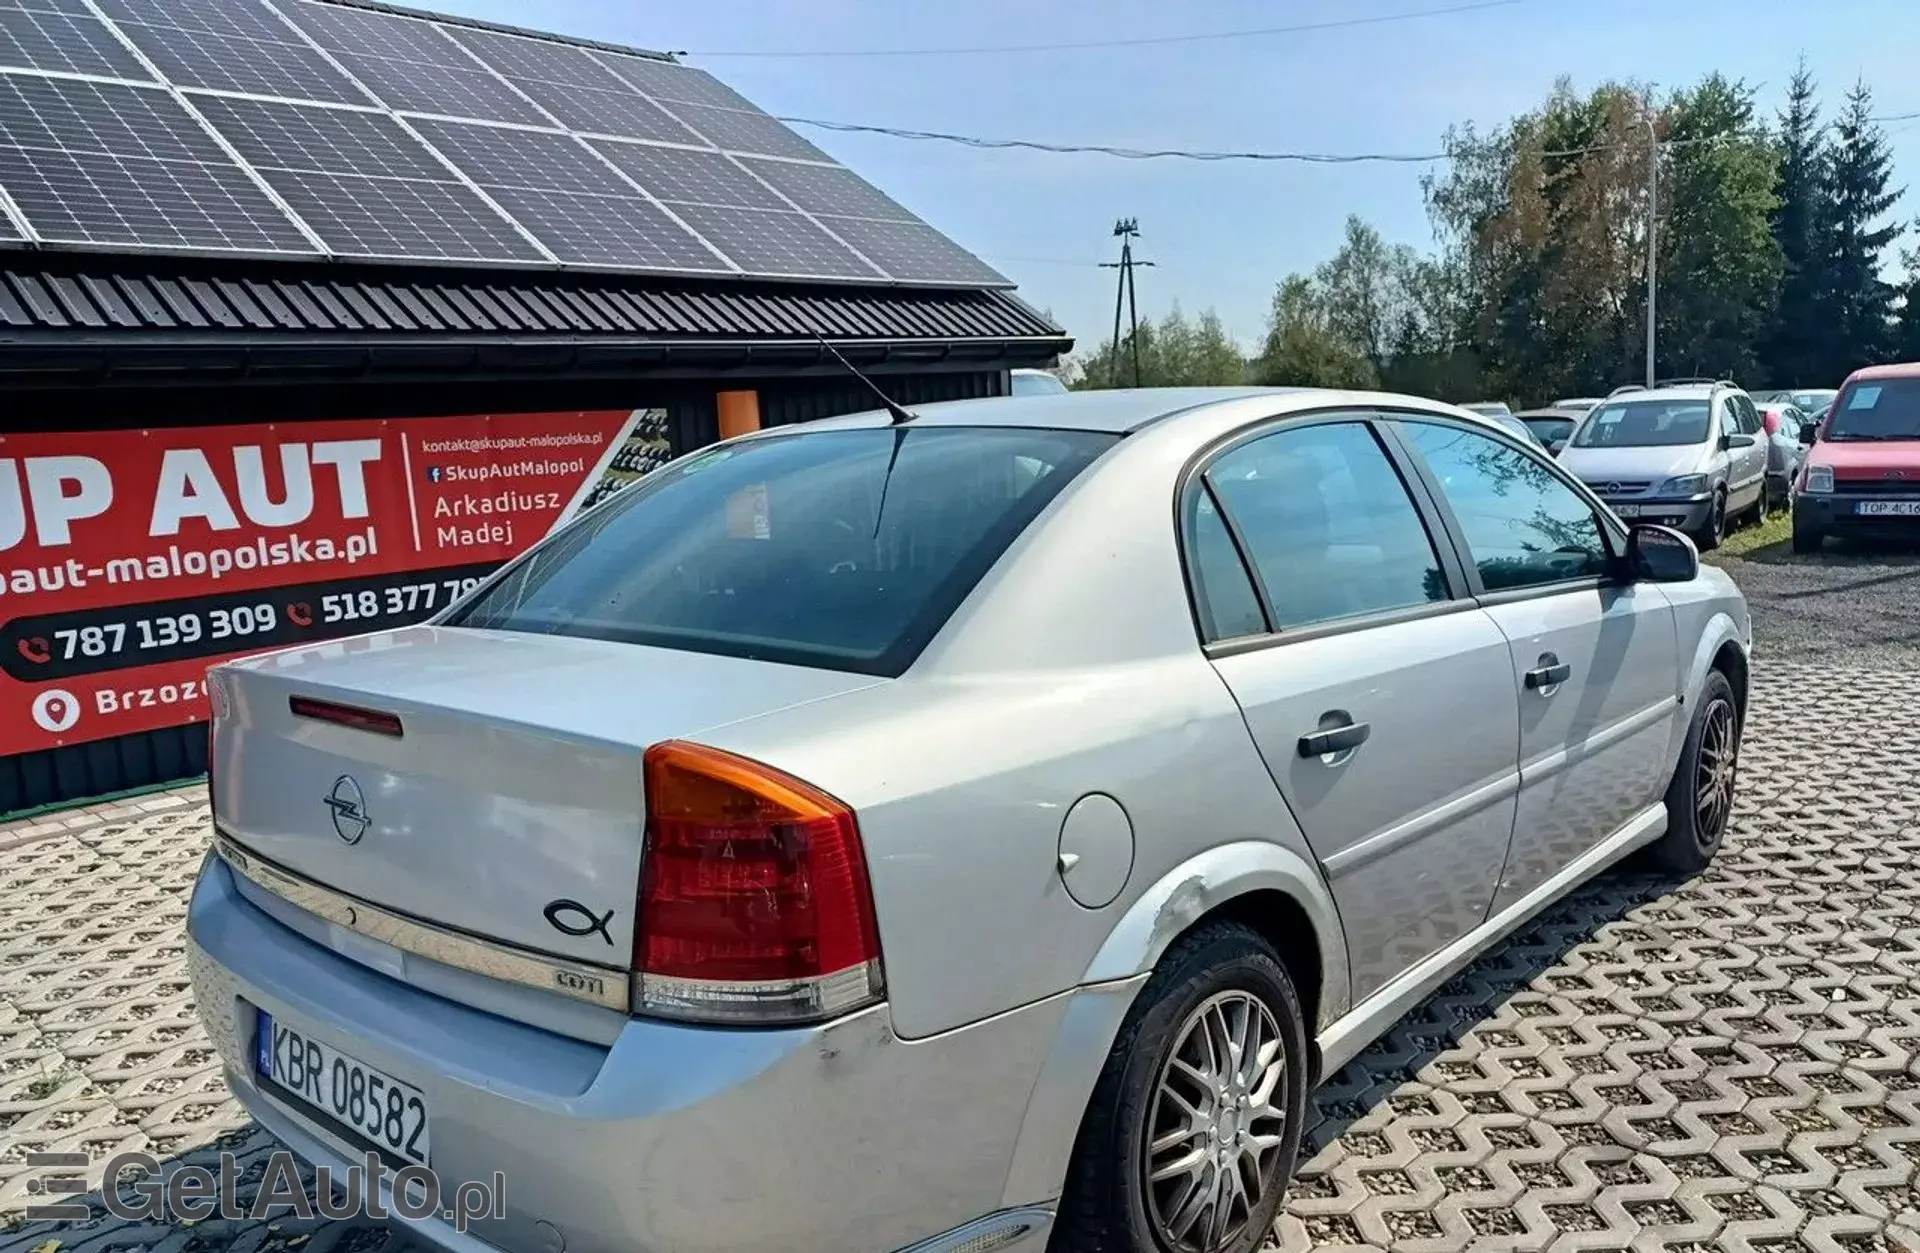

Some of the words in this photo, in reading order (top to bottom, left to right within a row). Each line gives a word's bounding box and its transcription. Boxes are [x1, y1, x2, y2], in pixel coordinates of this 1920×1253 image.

[422, 432, 603, 453] kontakt@skupaut-malopolska.pl
[149, 438, 382, 536] AUT
[445, 458, 585, 482] SkupAutMalopol
[434, 491, 561, 518] Arkadiusz
[437, 521, 514, 548] Madej
[0, 526, 378, 596] aut-malopolska.pl
[322, 590, 378, 623] 518
[384, 582, 437, 614] 377
[54, 622, 126, 660] 787
[136, 612, 201, 649] 139
[209, 603, 277, 639] 309
[273, 1022, 323, 1103] KBR
[332, 1056, 426, 1163] 08582
